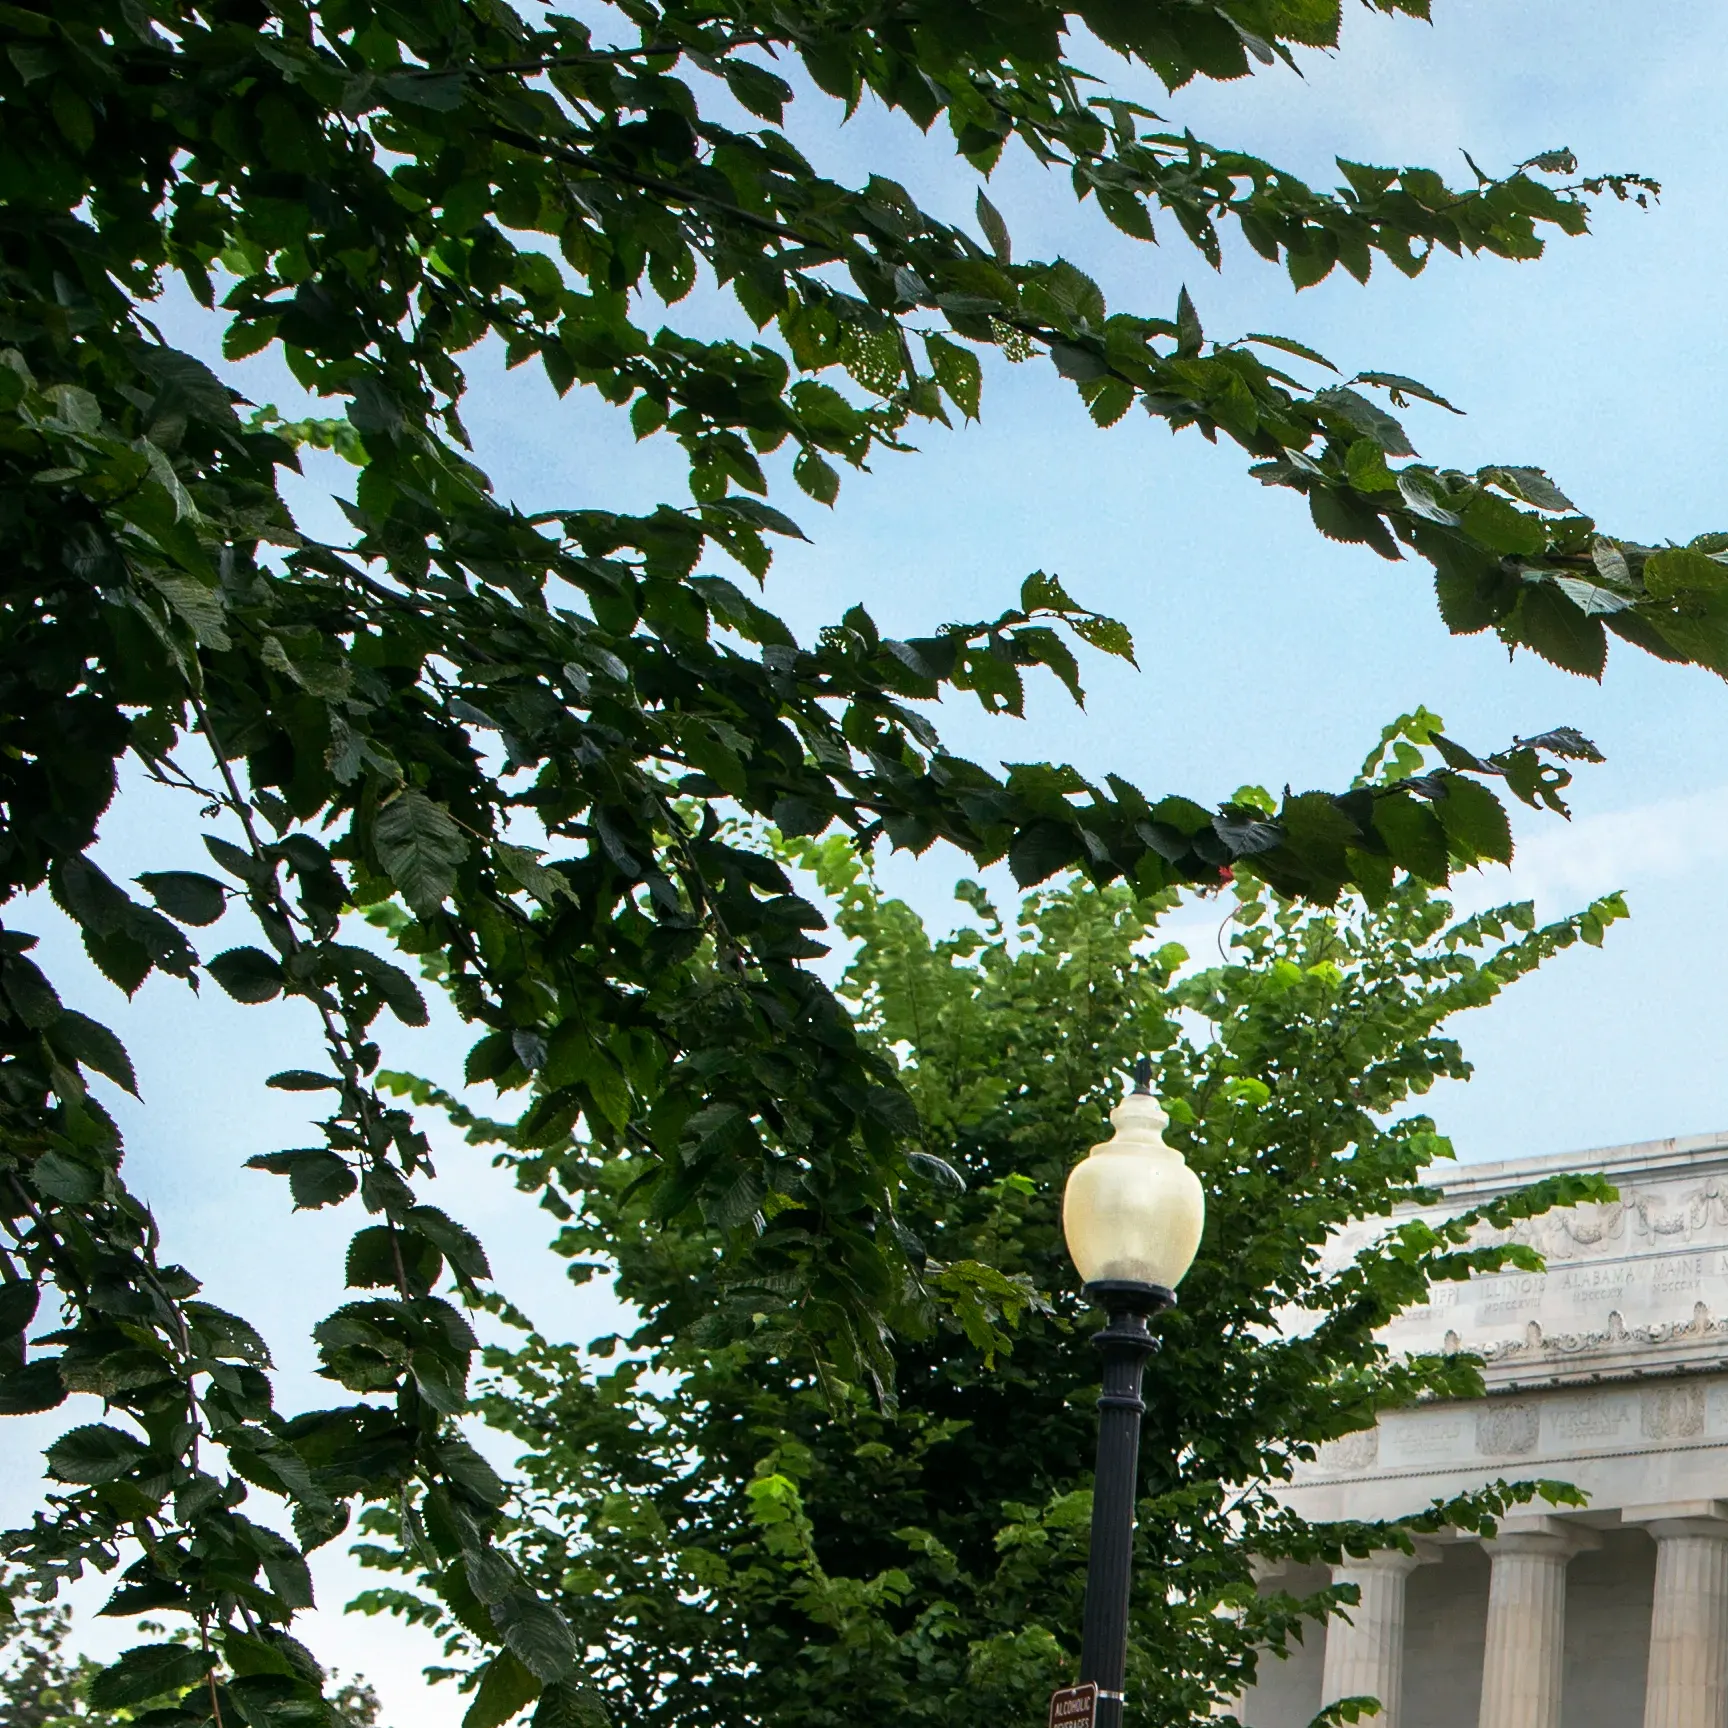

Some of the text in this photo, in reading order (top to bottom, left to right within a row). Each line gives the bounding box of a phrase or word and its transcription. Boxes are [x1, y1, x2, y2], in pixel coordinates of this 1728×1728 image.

[1562, 1267, 1636, 1290] ALABAMA
[1653, 1258, 1702, 1281] MAINE
[1480, 1277, 1546, 1299] ILLINOIS
[1055, 1696, 1091, 1717] ALCOHOLIC
